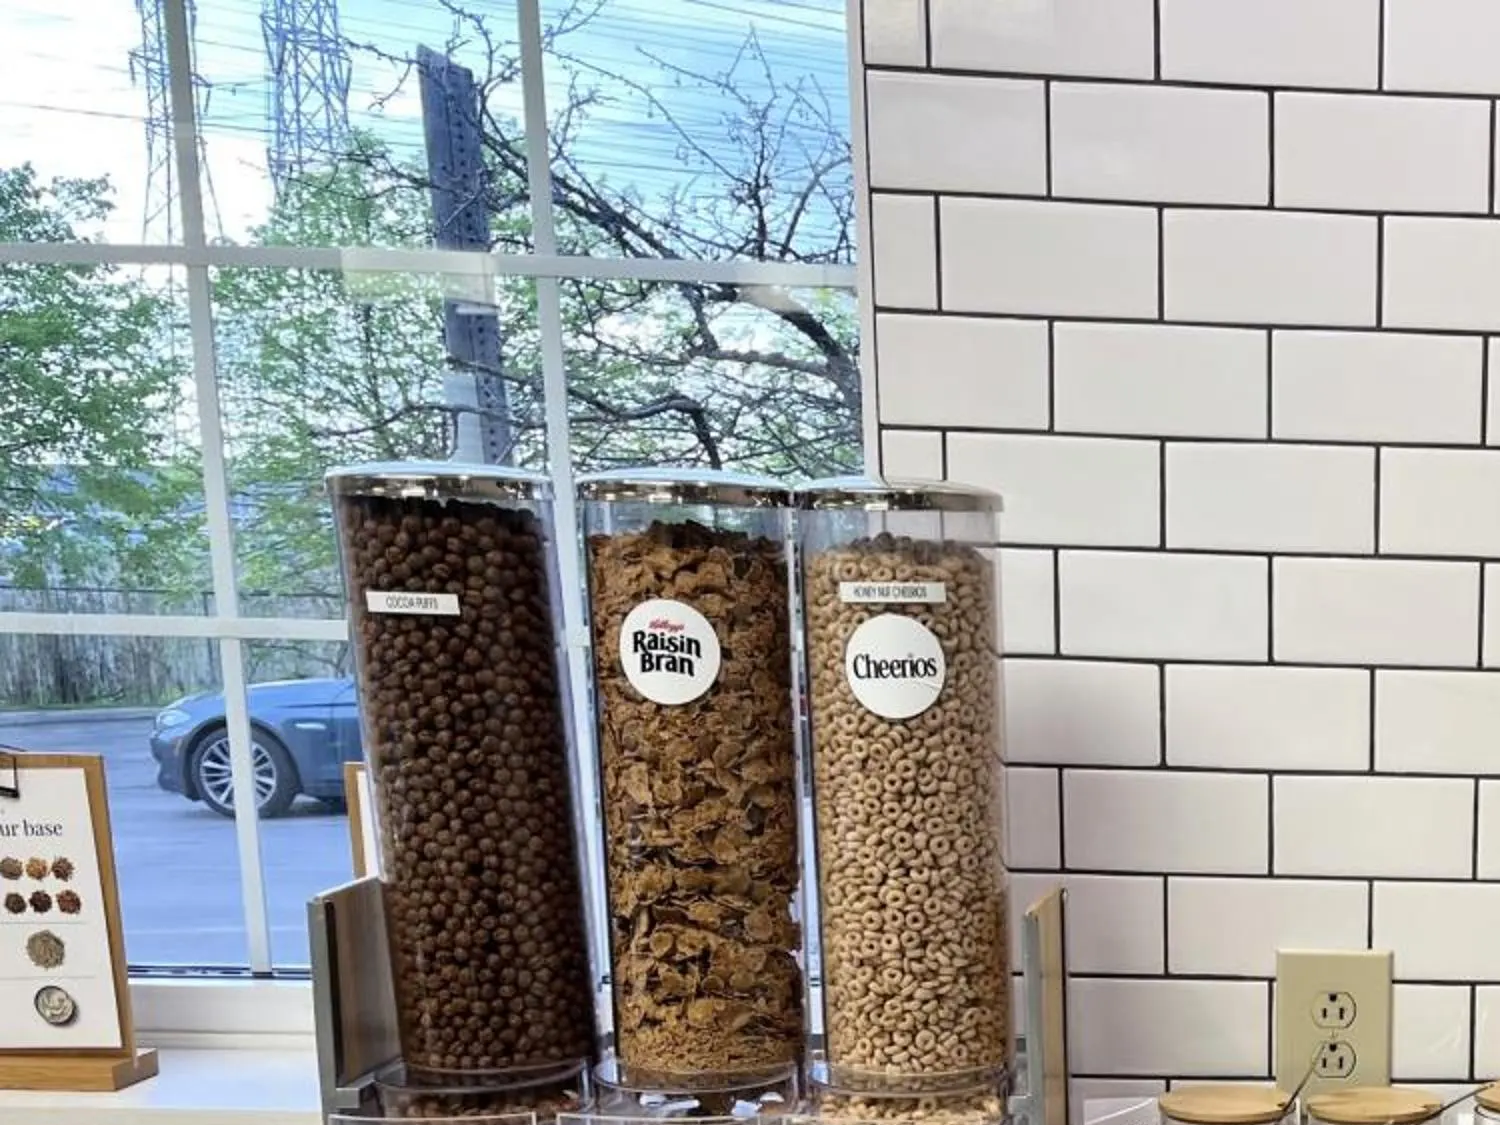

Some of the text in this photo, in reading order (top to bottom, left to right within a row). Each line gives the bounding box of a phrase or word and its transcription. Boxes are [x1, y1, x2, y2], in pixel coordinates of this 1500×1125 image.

[632, 629, 702, 659] Raisin
[640, 652, 695, 677] Bran
[852, 652, 938, 680] Cheerios
[22, 818, 63, 837] base
